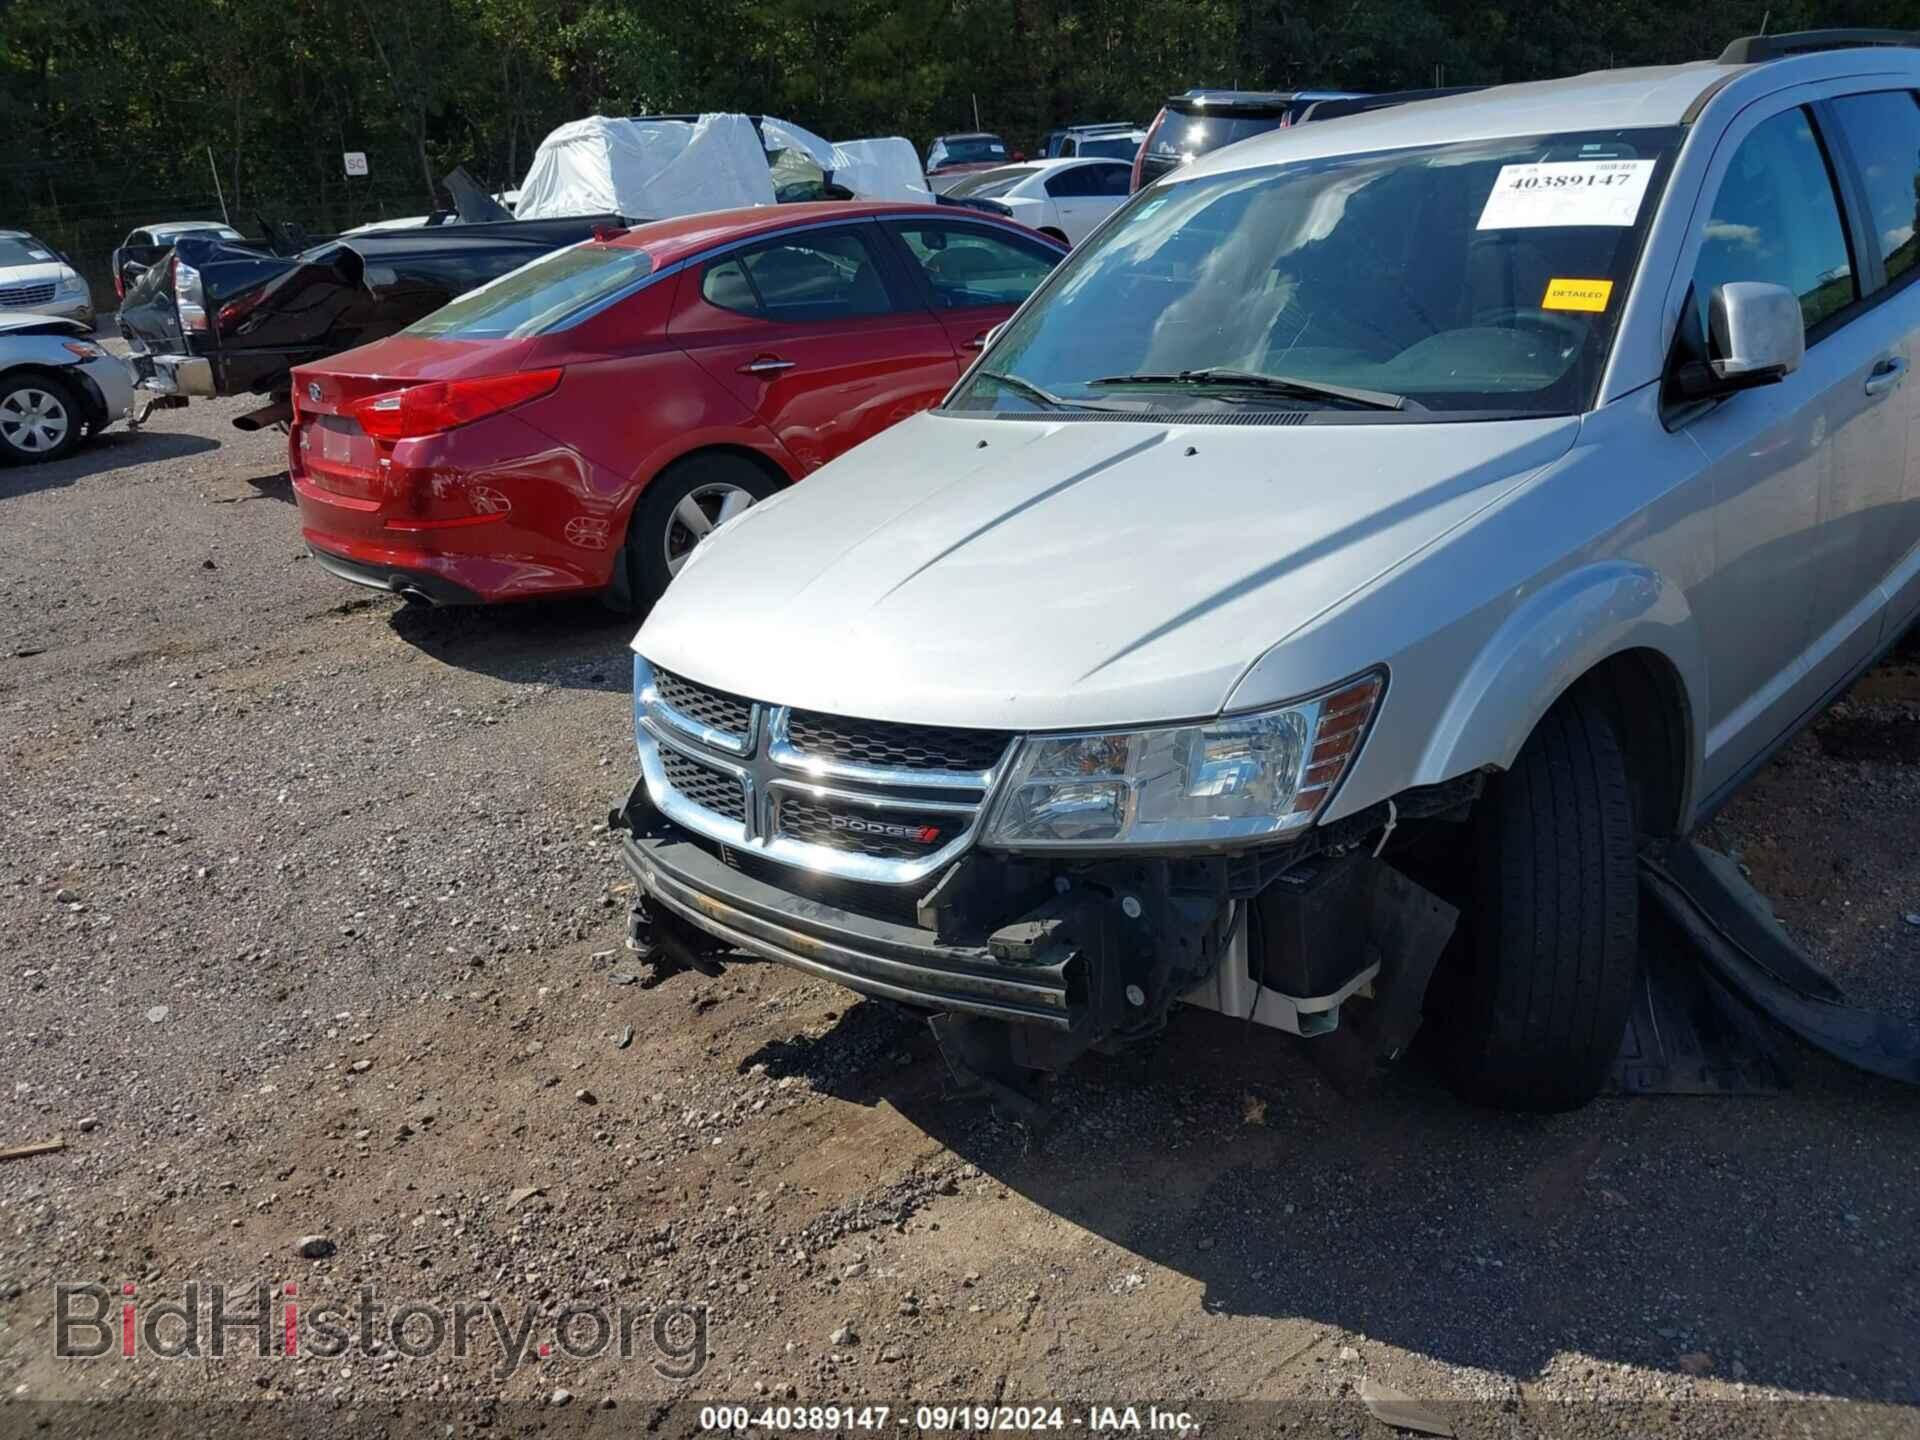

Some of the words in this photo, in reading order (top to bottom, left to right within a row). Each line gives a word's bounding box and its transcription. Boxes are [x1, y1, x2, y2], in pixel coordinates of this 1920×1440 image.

[1510, 174, 1631, 189] 40389147
[1552, 290, 1603, 299] DETAILED
[831, 816, 921, 838] DODGE
